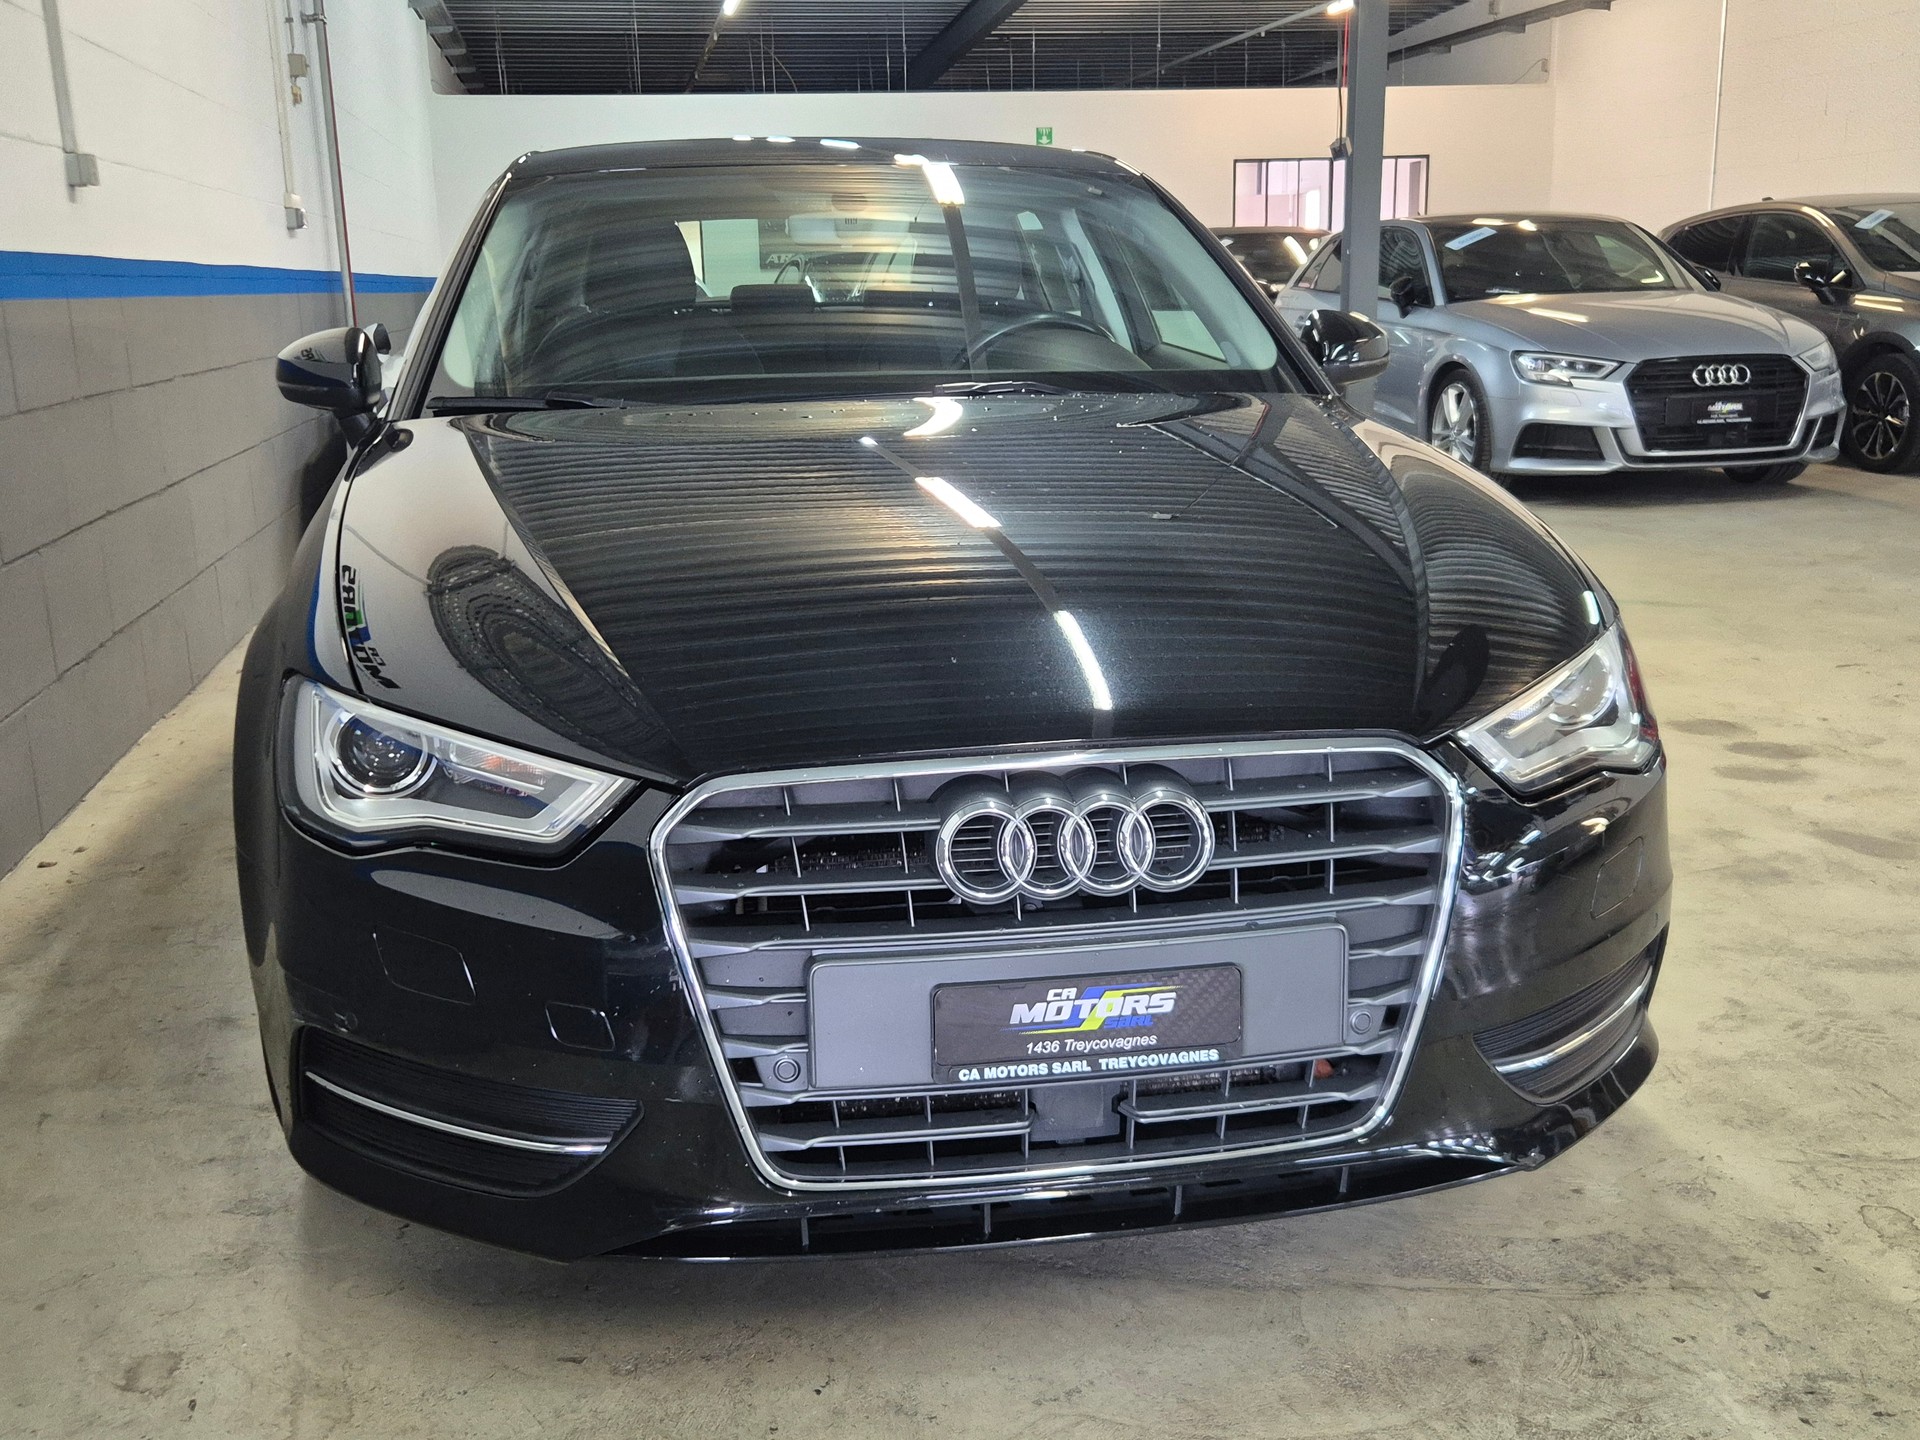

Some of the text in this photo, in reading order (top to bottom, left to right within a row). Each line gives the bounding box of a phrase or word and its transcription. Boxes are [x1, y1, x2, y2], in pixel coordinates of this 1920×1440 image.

[1046, 987, 1078, 1001] CA
[1009, 992, 1177, 1025] MOTORS
[1026, 1035, 1158, 1055] 1436 Treycovagnes
[958, 1048, 1220, 1081] CA MOTORS SARL TREYCOVAGNES
